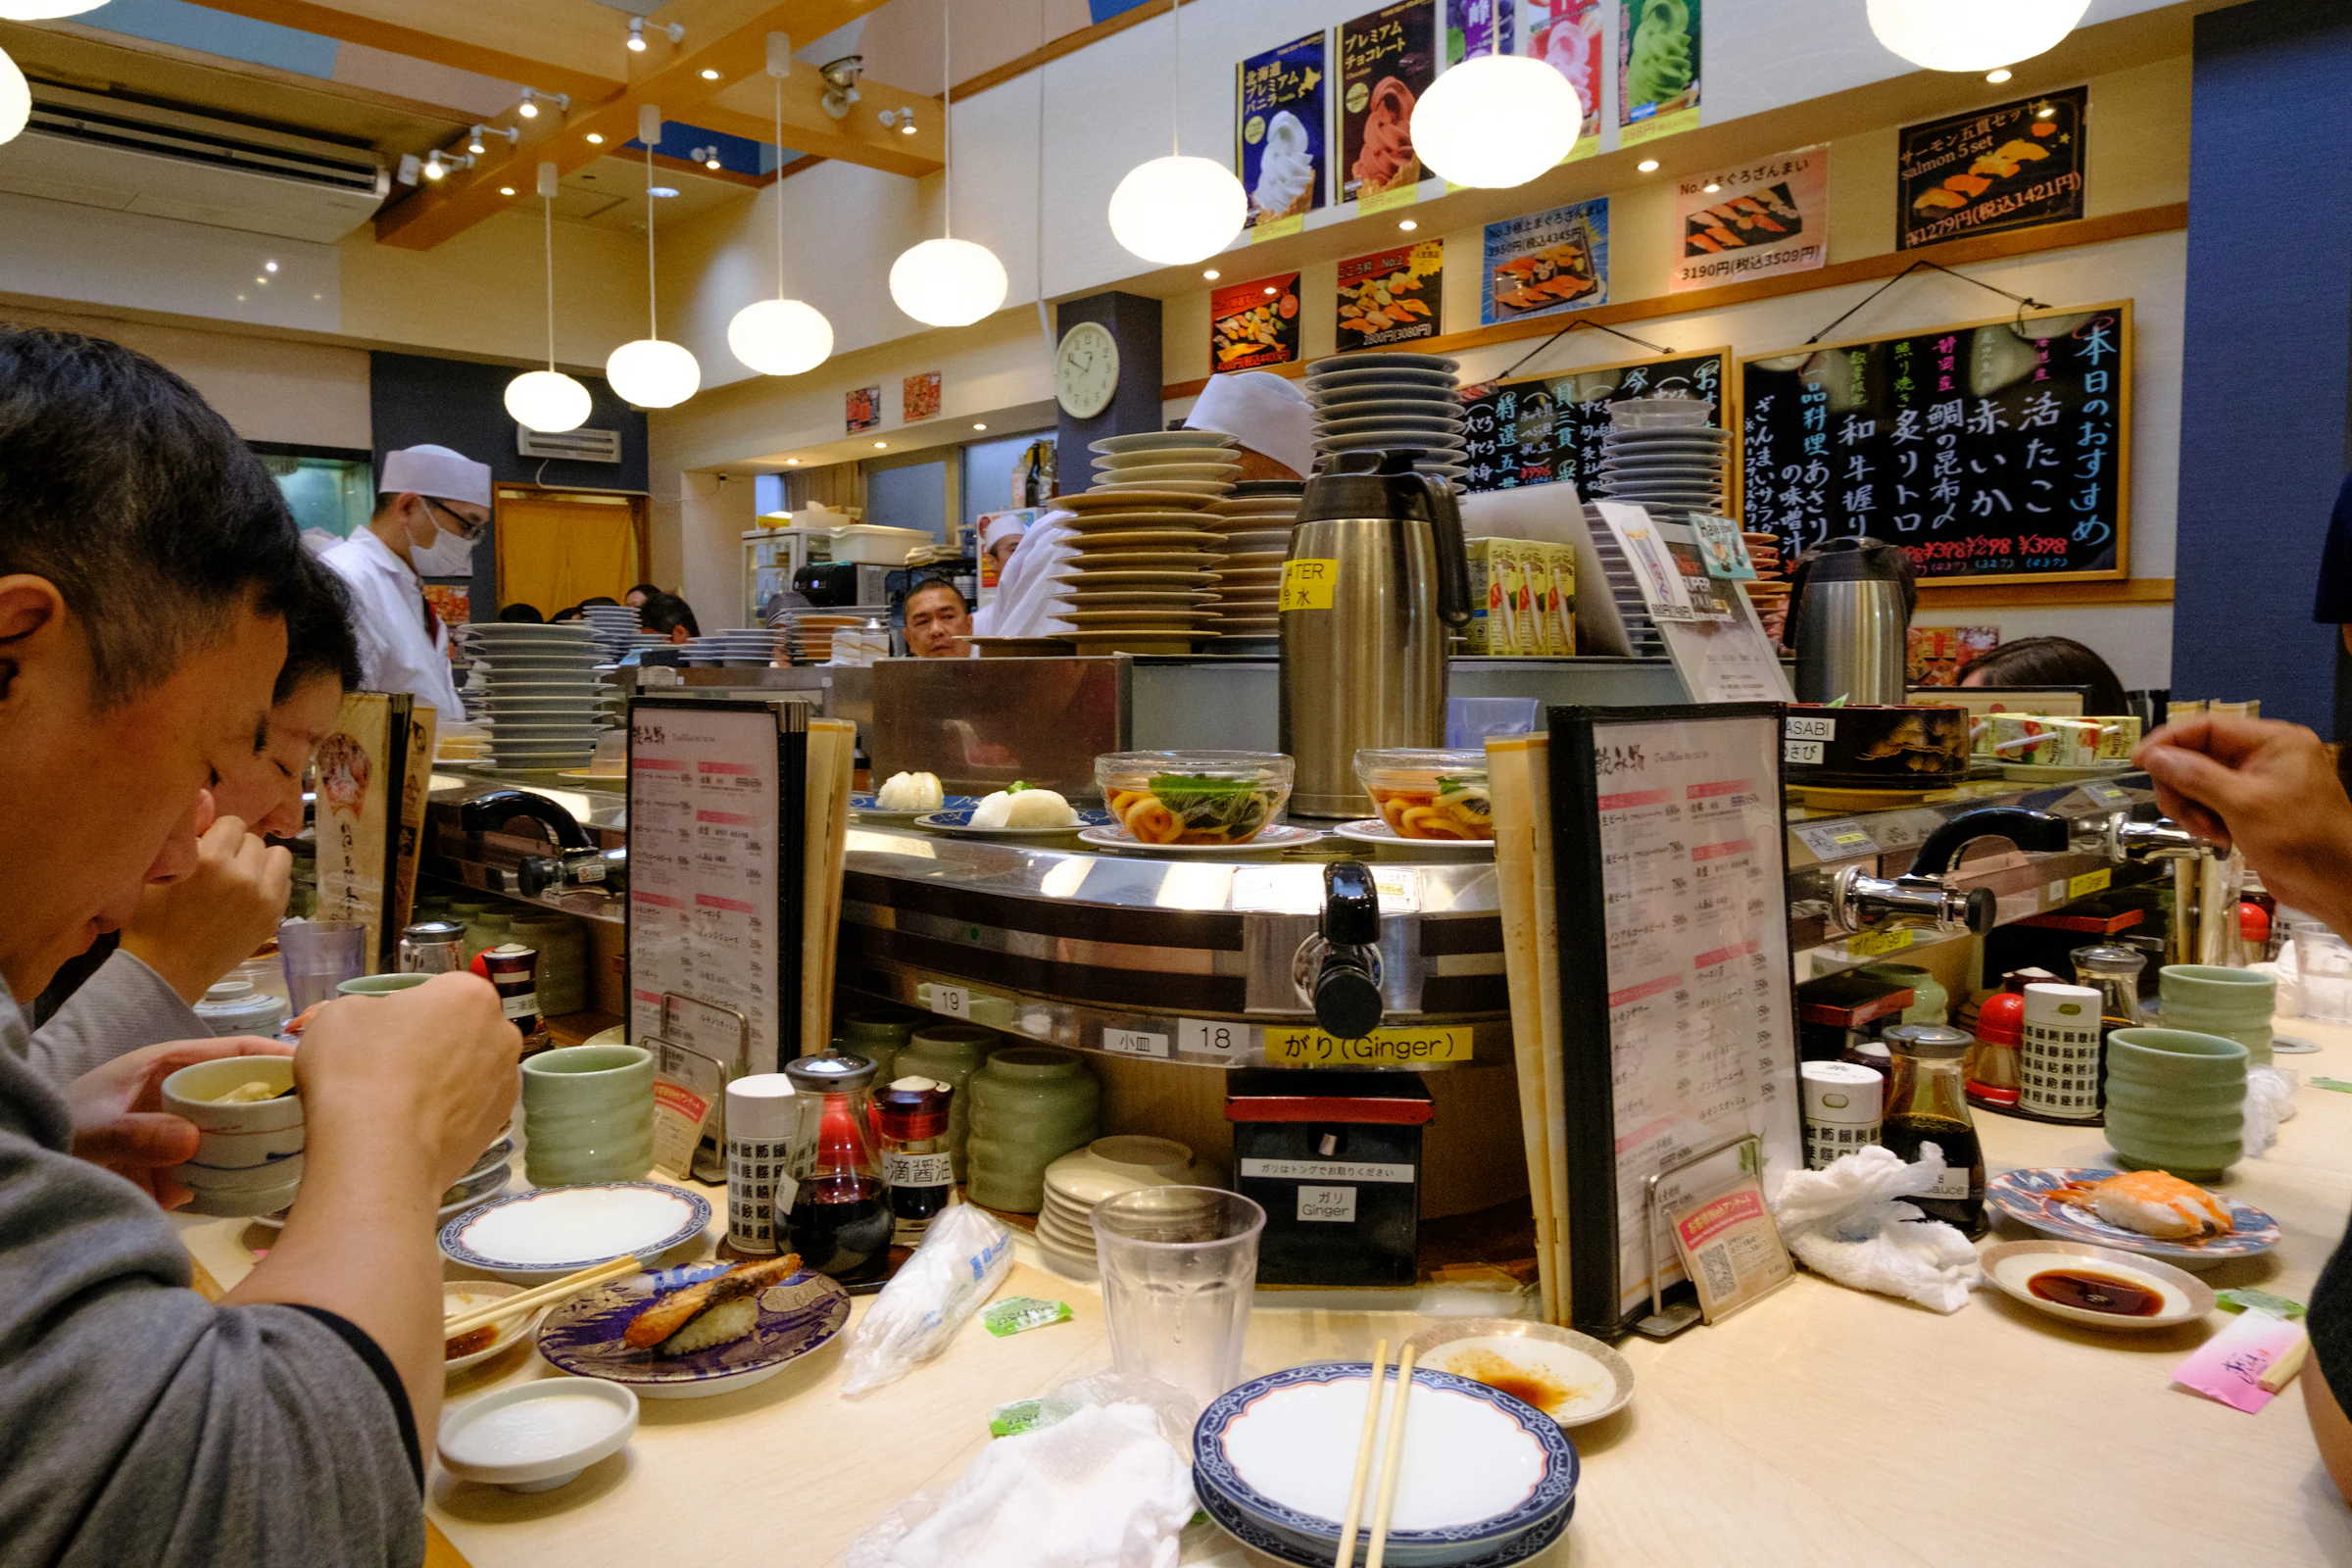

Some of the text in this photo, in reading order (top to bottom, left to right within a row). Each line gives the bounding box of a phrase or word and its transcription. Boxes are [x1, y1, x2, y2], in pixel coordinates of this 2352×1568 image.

[1345, 21, 1402, 53] プレミアム
[1345, 36, 1406, 71] チョコレート
[1247, 71, 1299, 102] プレミアム
[1245, 93, 1277, 116] バニラ
[1900, 102, 2036, 166] サーモン五貫セット
[1901, 135, 1994, 181] salmon 5 set
[2070, 325, 2118, 547] 本日のおすすめ
[1466, 440, 1495, 459] 中とろ
[1967, 398, 2012, 516] 赤いか
[2017, 390, 2062, 514] 活たこ
[2018, 533, 2068, 556] ¥398
[1285, 564, 1324, 580] ATER
[1786, 721, 1830, 736] ASABI
[942, 992, 959, 1011] 19
[1119, 1034, 1152, 1054] 小皿
[1200, 1027, 1231, 1050] 18
[885, 1159, 952, 1184] 滴醤油
[1261, 1163, 1395, 1177] ガリはトングでお取りください
[1318, 1192, 1344, 1204] ガリ
[1301, 1204, 1349, 1217] Ginger
